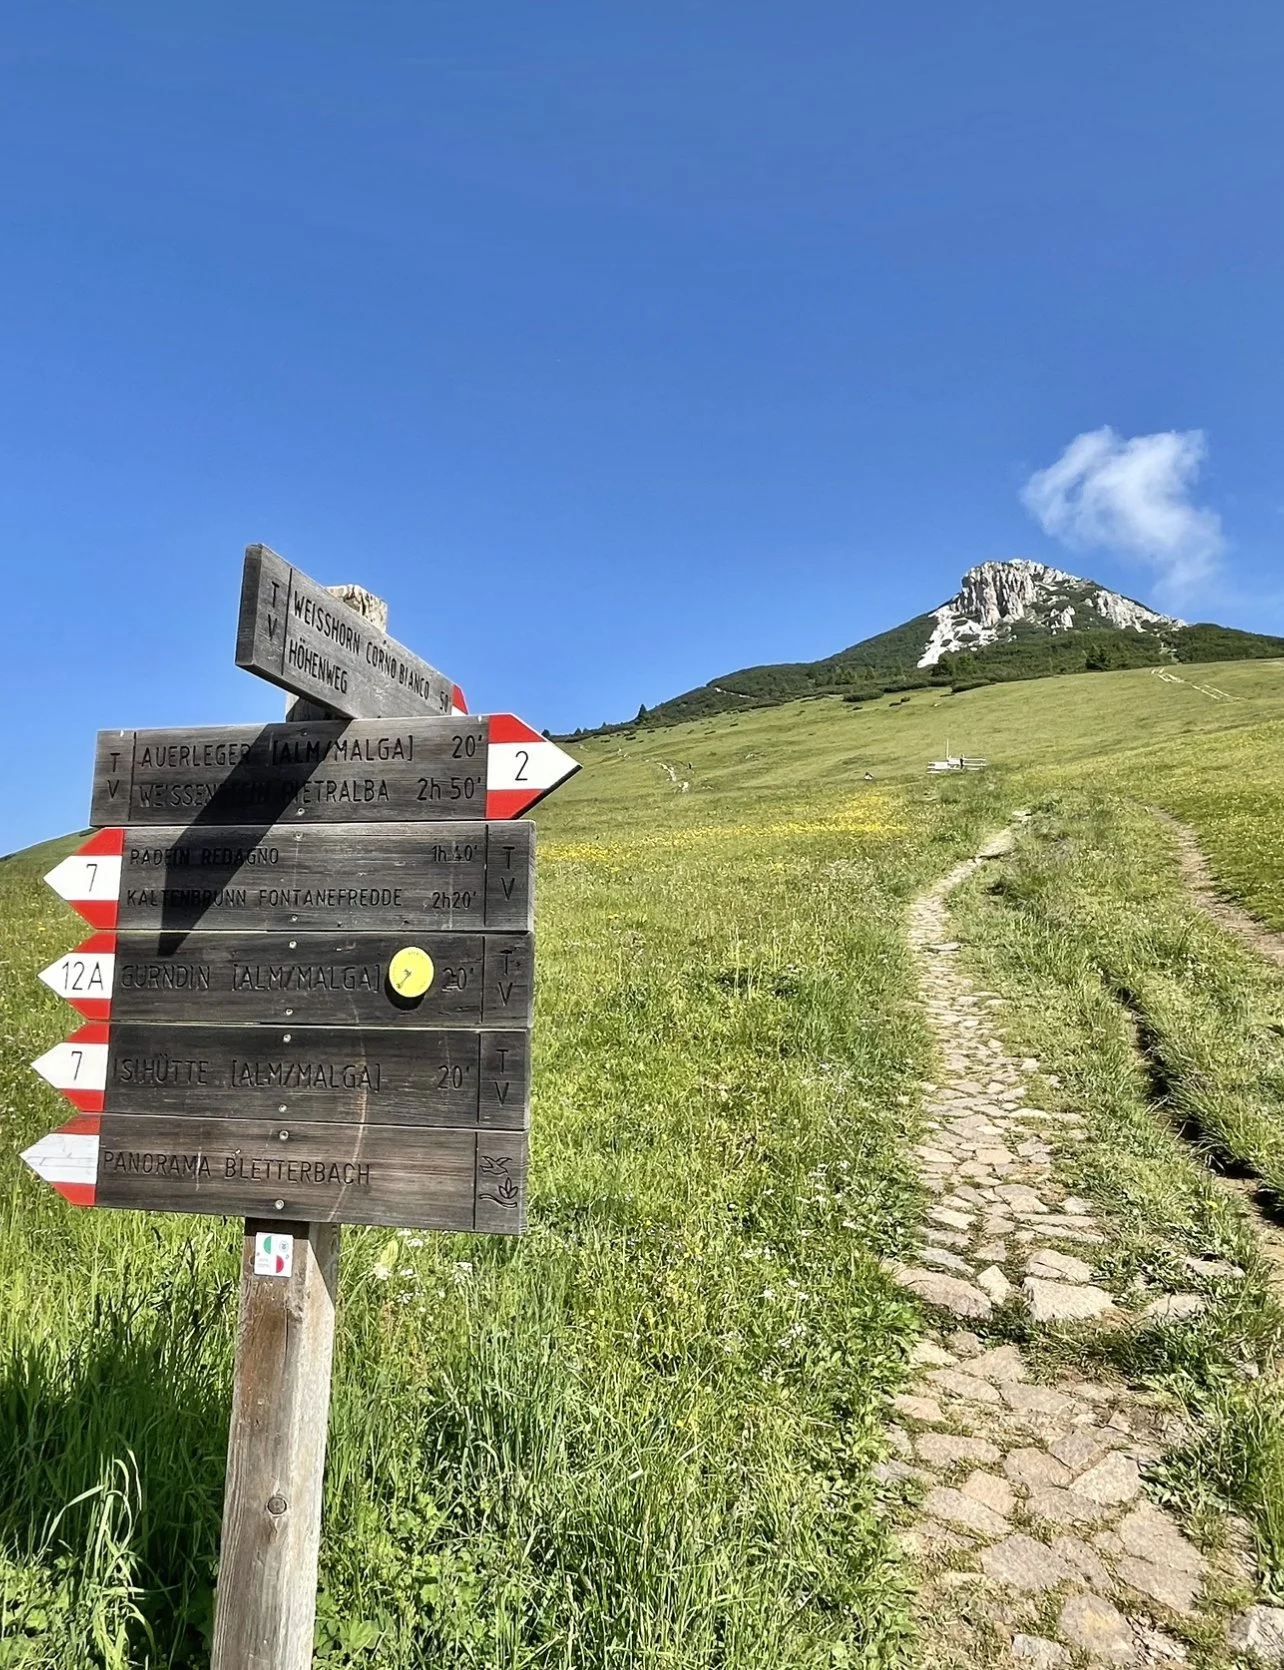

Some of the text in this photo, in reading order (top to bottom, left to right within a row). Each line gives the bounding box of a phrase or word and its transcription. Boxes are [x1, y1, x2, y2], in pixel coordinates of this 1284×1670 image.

[273, 581, 280, 608] T
[268, 614, 278, 641] V
[294, 591, 361, 654] WEISSHORN
[366, 641, 397, 679] CORNO
[398, 664, 430, 701] BIANCO
[289, 638, 348, 694] HÖHENWEG
[110, 752, 121, 773] T
[141, 734, 483, 768] AUERLEGER [ALM/MALGA] 20'
[515, 750, 529, 781] 2
[107, 780, 120, 799] V
[282, 778, 389, 804] PIETRALBA
[130, 848, 191, 866] RADEIN
[203, 847, 279, 866] REDAGNO
[503, 846, 516, 870] T
[86, 863, 99, 893] 7
[502, 877, 516, 901] V
[127, 889, 247, 907] KALTENBRUNN
[259, 887, 402, 907] FONTANEFREDDE
[62, 961, 104, 991] 12A
[500, 949, 513, 976] T
[121, 964, 474, 993] GURNDIN [ALM/MALGA] 20'
[498, 982, 513, 1006] V
[71, 1050, 83, 1081] 7
[496, 1049, 509, 1073] T
[232, 1059, 381, 1092] [ALM/MALGA]
[437, 1064, 470, 1089] 20'
[494, 1081, 510, 1106] V
[103, 1150, 370, 1186] PANORAMA BLETTERBACH
